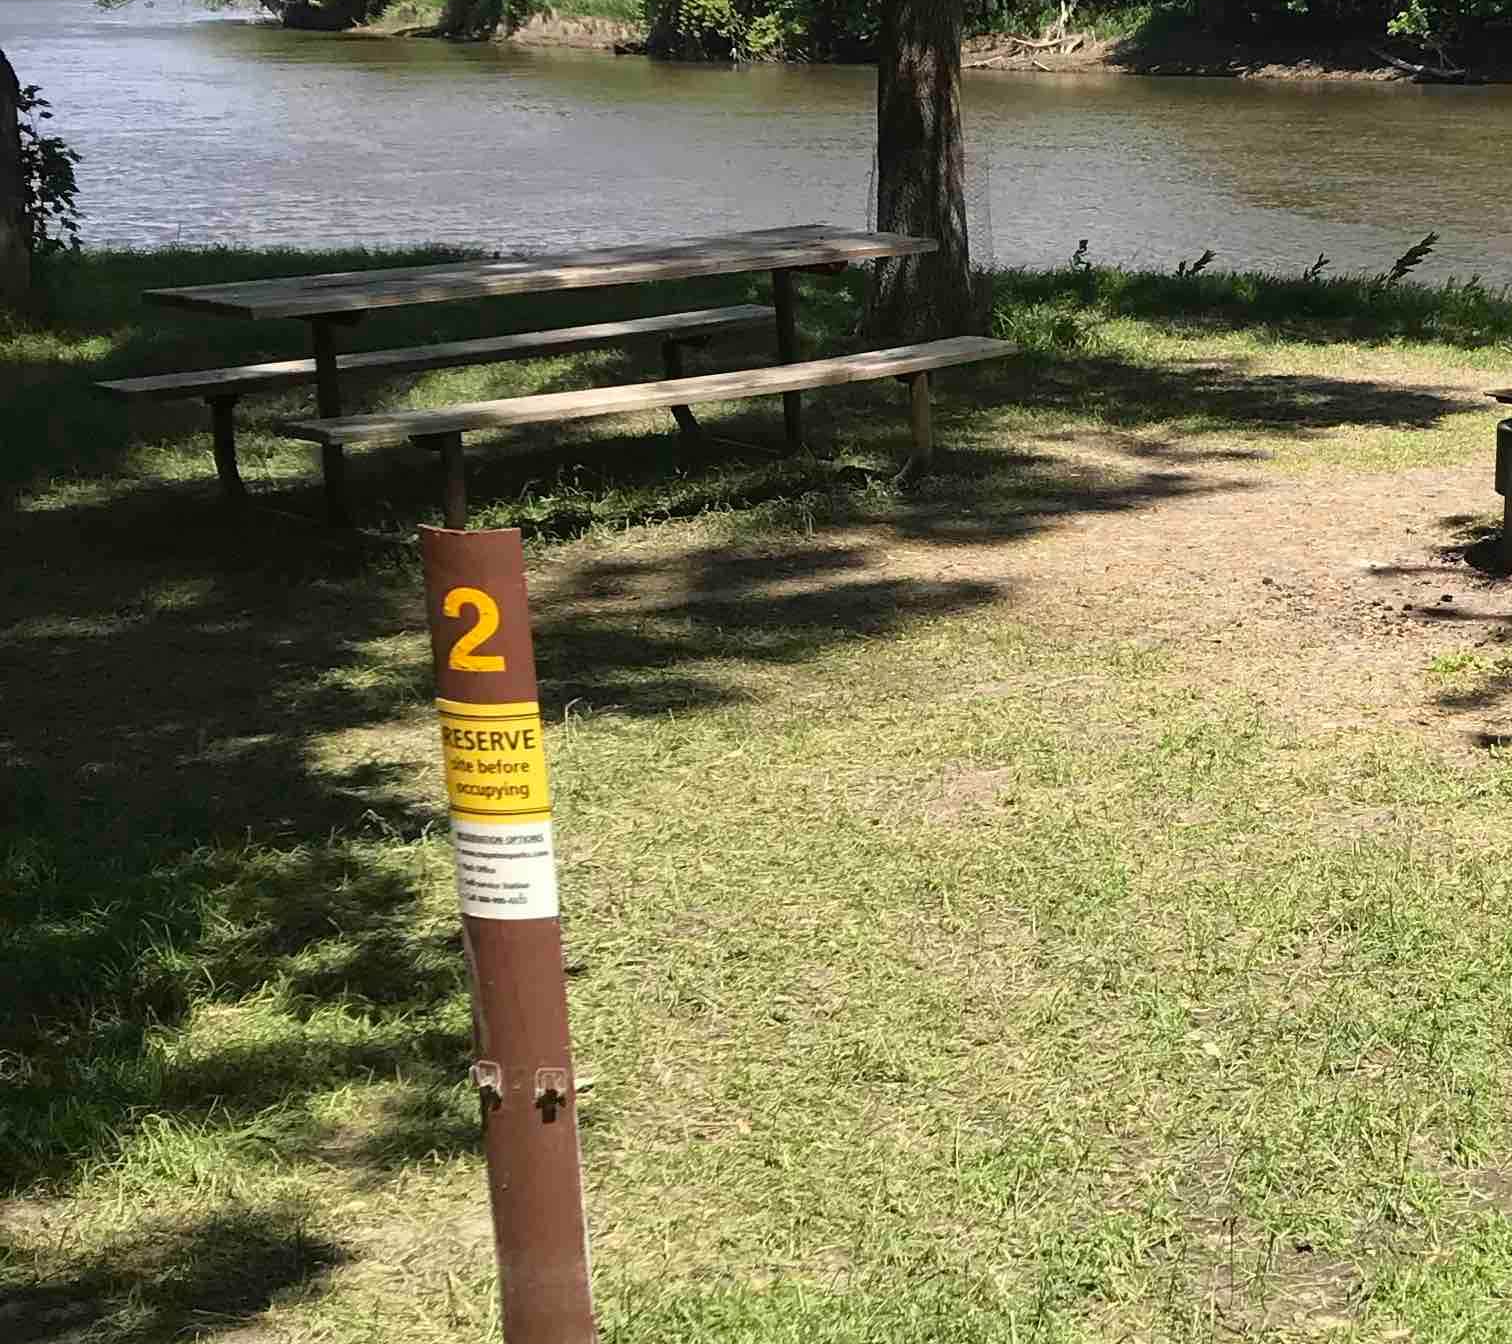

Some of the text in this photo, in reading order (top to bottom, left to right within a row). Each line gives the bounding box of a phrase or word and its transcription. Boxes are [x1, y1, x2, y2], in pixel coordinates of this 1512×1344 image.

[443, 587, 506, 672] 2
[441, 726, 536, 751] RESERVE
[477, 759, 530, 774] before
[456, 781, 530, 800] occupying
